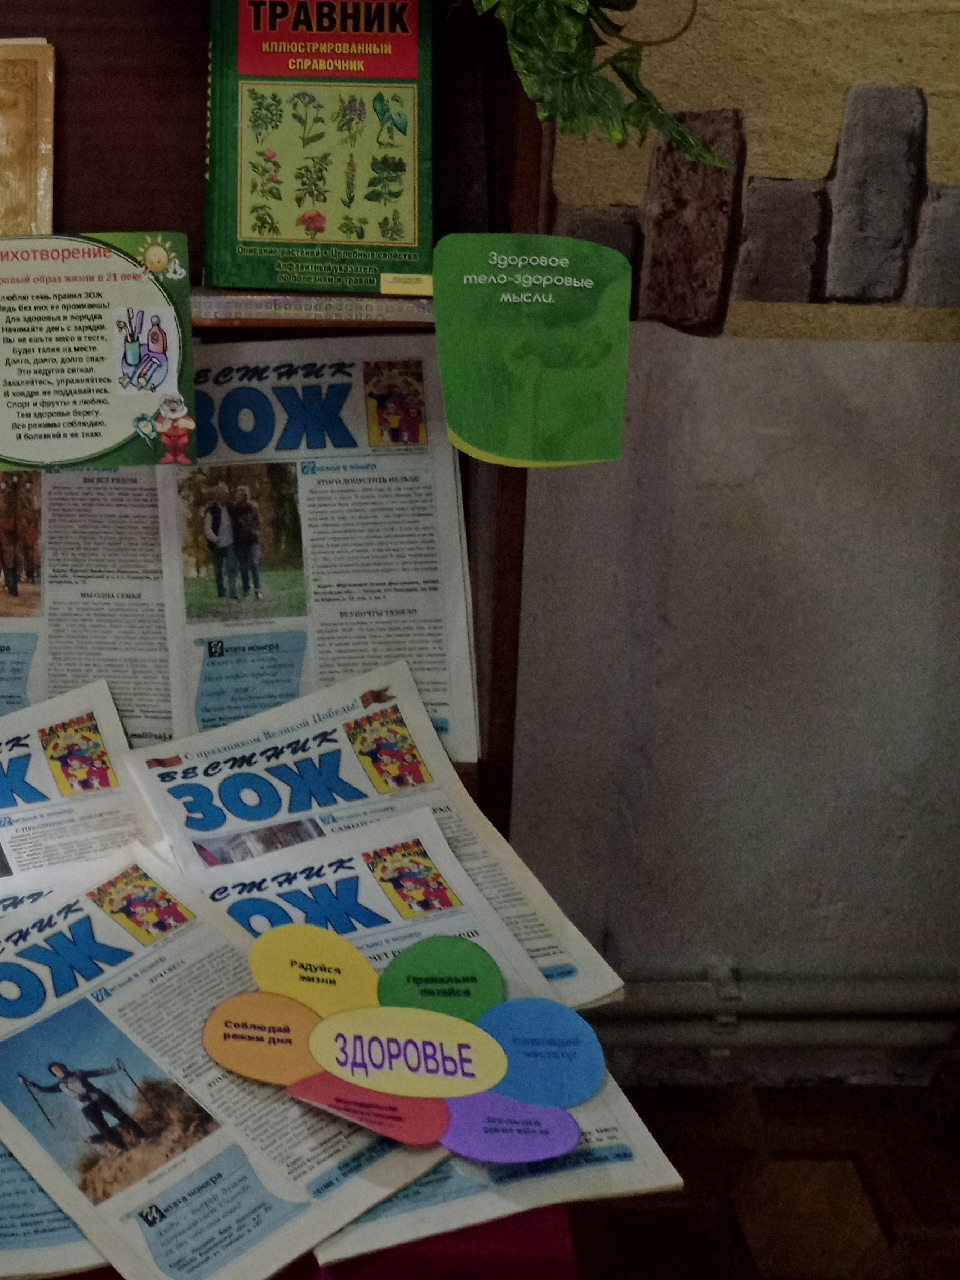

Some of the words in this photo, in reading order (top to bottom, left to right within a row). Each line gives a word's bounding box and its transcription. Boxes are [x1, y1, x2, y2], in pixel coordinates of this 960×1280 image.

[248, 0, 410, 34] ТРАВНИК
[262, 41, 392, 55] ИЛЛЮСТРИРОВАННЫЙ
[288, 58, 364, 71] СПРАВОЧНИК
[237, 245, 279, 257] Описание
[280, 248, 322, 260] растений
[488, 252, 570, 270] Здоровое
[33, 275, 62, 285] образ
[64, 274, 95, 283] жизни
[106, 273, 117, 281] 21
[463, 273, 595, 289] тело-здоровые
[194, 360, 357, 383] ЕСТНИК
[157, 729, 339, 783] ВЕСТНИК
[166, 749, 369, 832] ЗОЖ
[208, 858, 358, 902] СТНИК
[225, 876, 392, 941] ОЖ
[290, 959, 342, 976] Радуйся
[298, 973, 338, 986] жизни
[333, 1032, 477, 1078] ЗДОРОВЬЕ
